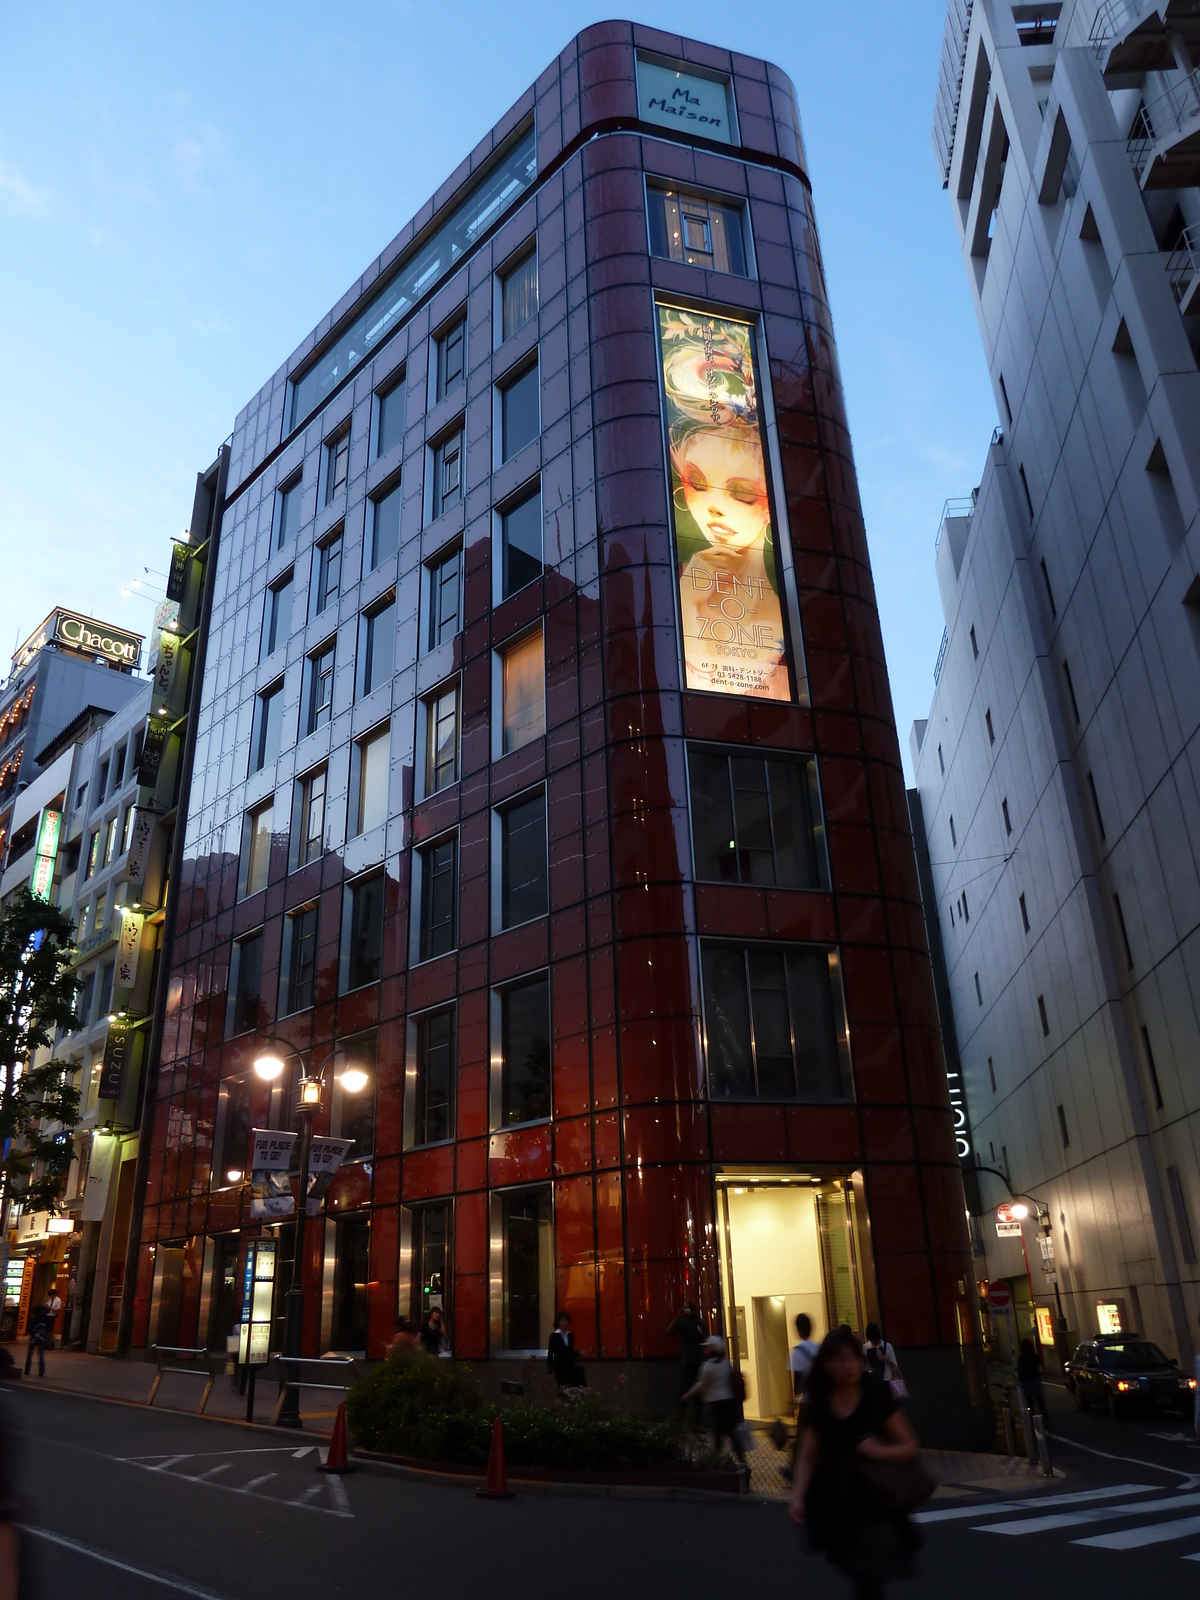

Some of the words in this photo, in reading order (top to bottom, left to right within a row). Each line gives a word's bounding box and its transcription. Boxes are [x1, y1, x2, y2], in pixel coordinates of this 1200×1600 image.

[672, 87, 701, 106] Ma
[648, 99, 721, 126] Maison
[690, 566, 767, 600] DENT
[61, 618, 137, 660] Chacott
[696, 616, 775, 651] ZONE
[716, 644, 758, 660] TOKYO
[717, 671, 762, 683] 03-5428-1188
[108, 1036, 126, 1084] SUZU
[256, 1140, 268, 1149] FUN
[269, 1140, 291, 1150] PLACE
[323, 1145, 344, 1156] PLACE
[260, 1151, 268, 1160] TO
[270, 1151, 281, 1161] GO!
[313, 1154, 321, 1163] TO
[322, 1154, 333, 1164] GO!
[21, 1262, 32, 1308] BREITLING
[17, 1311, 26, 1331] FAIR
